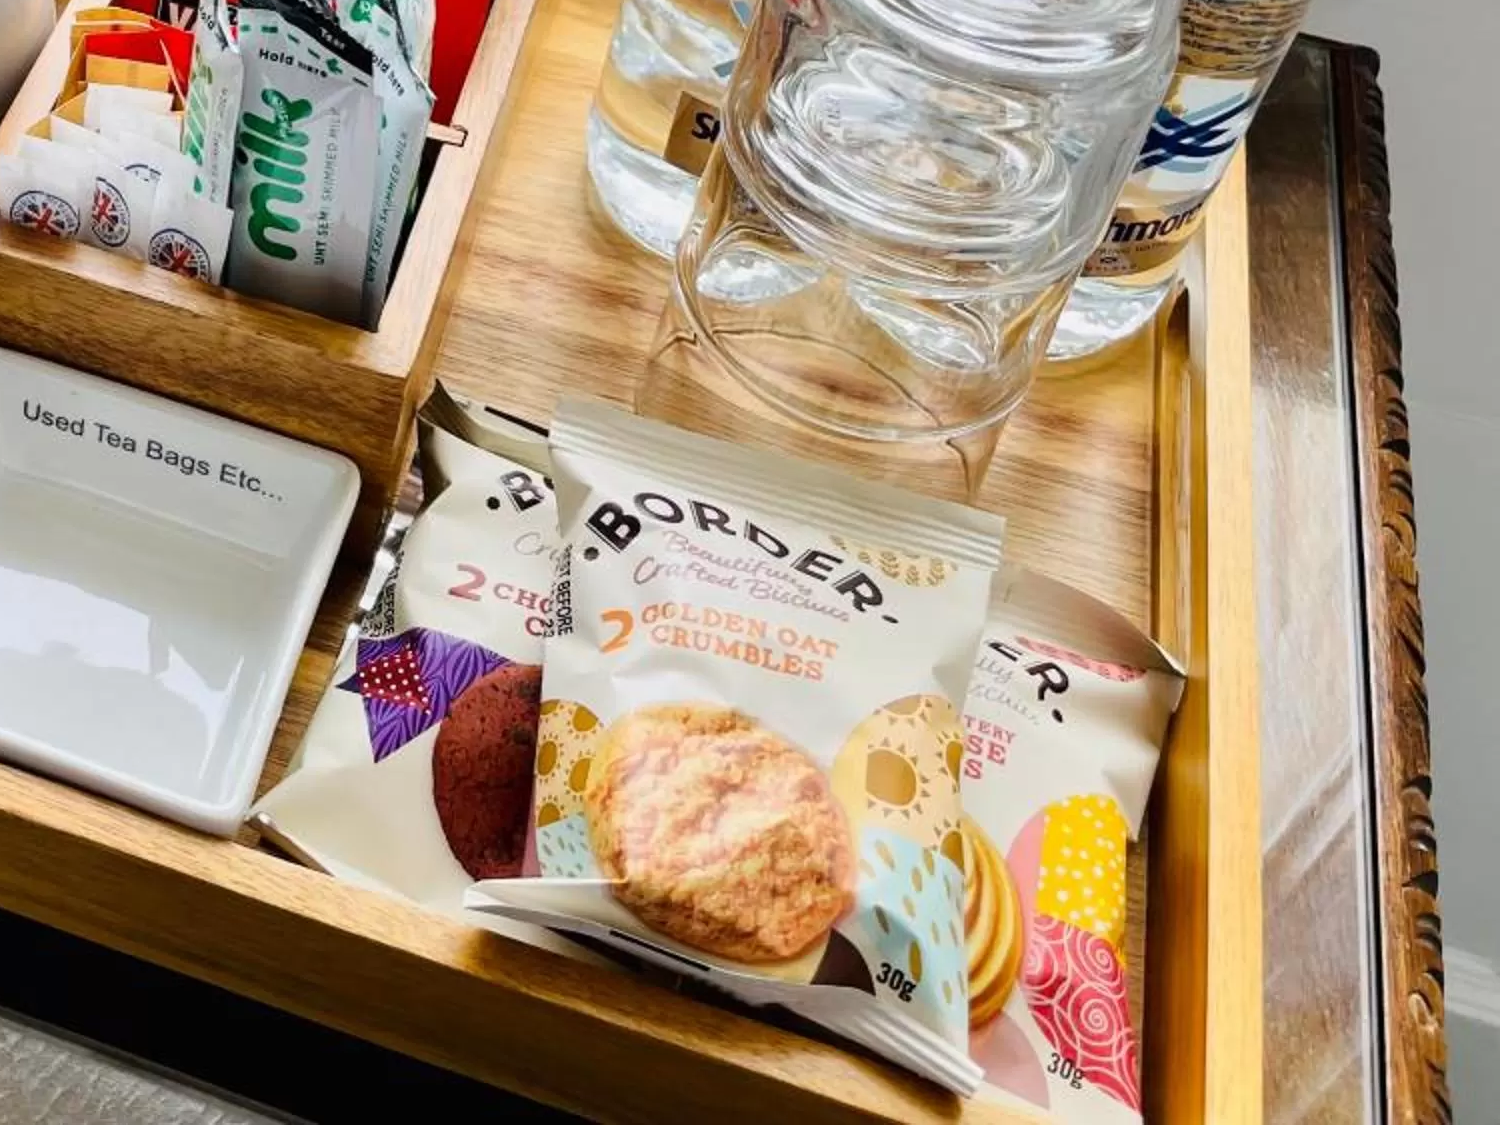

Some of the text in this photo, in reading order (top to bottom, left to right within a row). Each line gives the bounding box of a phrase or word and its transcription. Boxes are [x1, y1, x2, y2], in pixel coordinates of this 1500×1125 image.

[259, 48, 295, 67] Hold
[370, 52, 390, 74] old
[236, 88, 313, 261] milk
[316, 205, 331, 237] SEMI
[313, 240, 327, 266] UHT
[23, 400, 284, 502] Used Tea Bags Etc...
[586, 491, 885, 613] BORDER
[447, 563, 487, 602] 2
[633, 555, 740, 590] Crafted
[555, 579, 574, 636] BEFORE
[600, 601, 839, 659] 2 GOLDEN OAT
[651, 624, 824, 682] CRUMBLES
[875, 962, 917, 1003] 30g
[1046, 1052, 1088, 1090] 30g
